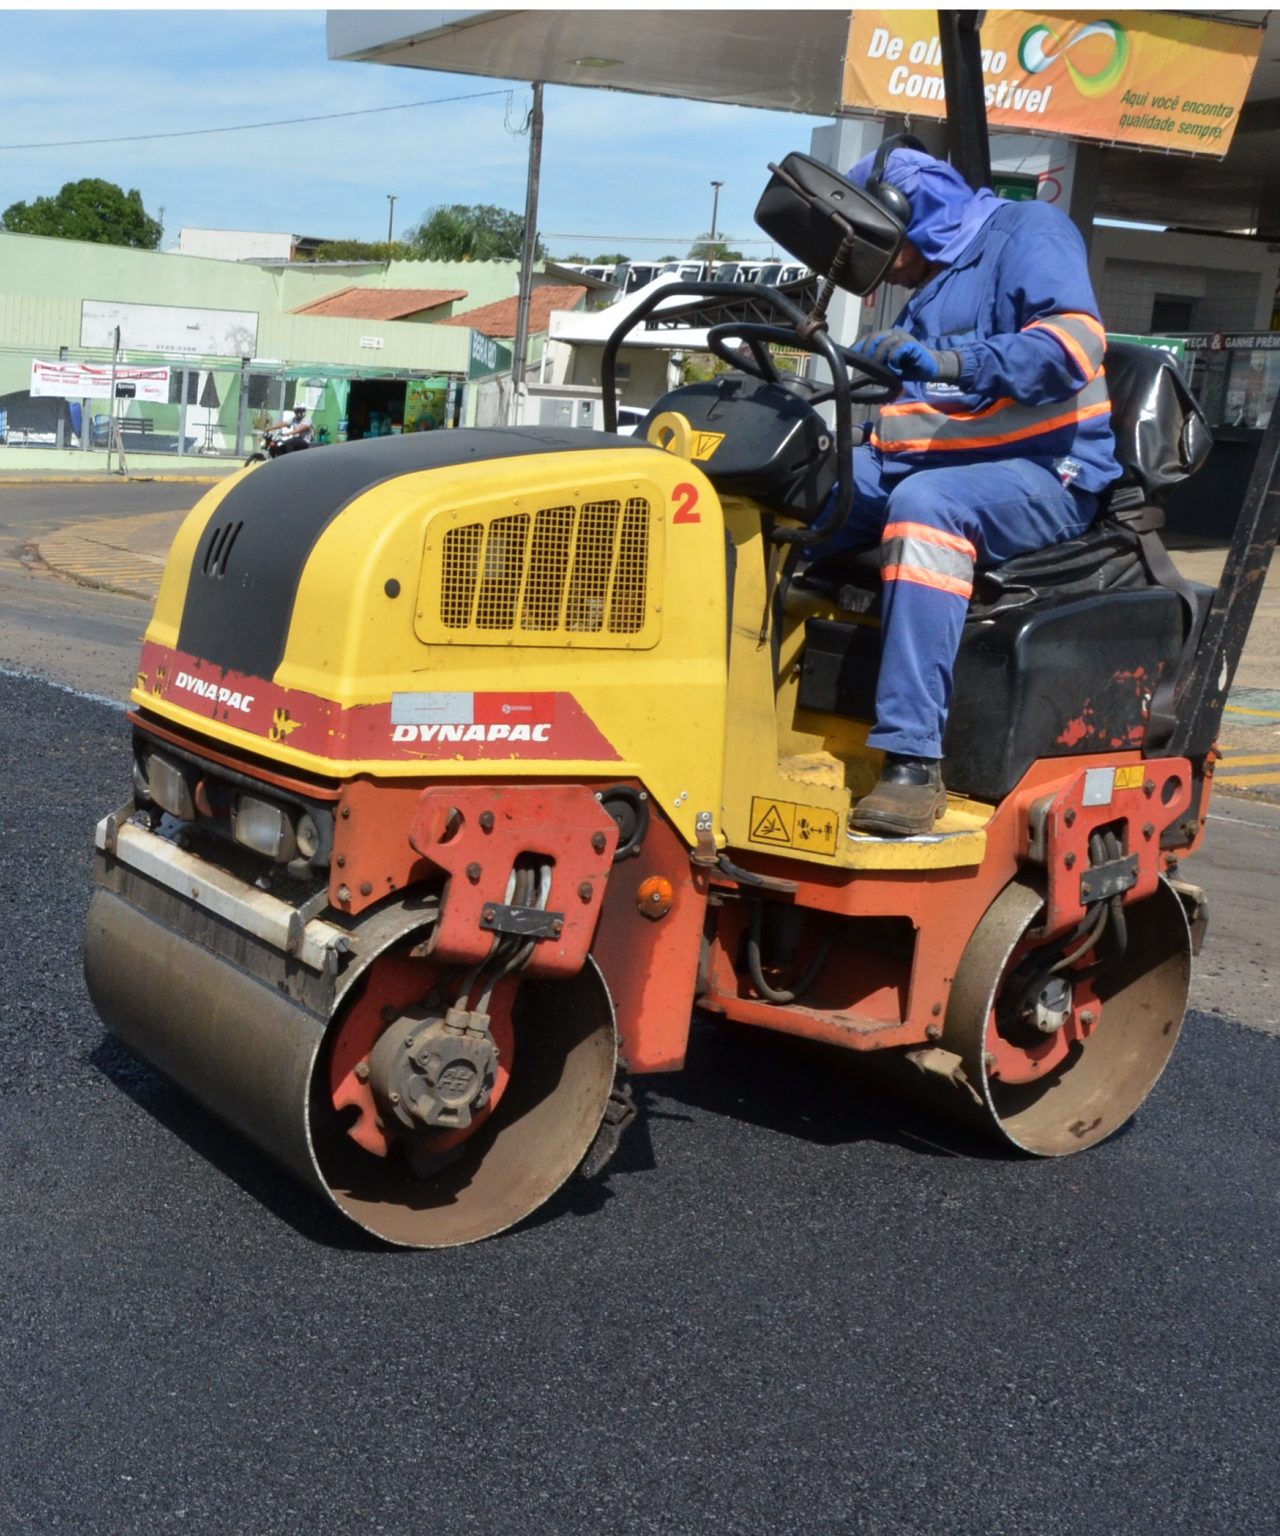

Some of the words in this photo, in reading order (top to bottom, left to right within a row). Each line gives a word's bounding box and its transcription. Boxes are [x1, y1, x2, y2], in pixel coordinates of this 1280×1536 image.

[867, 28, 904, 61] De
[888, 66, 1053, 113] Comstível
[1121, 89, 1150, 108] Aqui
[1151, 95, 1180, 111] você
[1181, 100, 1235, 118] encontra
[1119, 113, 1176, 132] qualidade
[1211, 334, 1222, 350] &
[1224, 337, 1255, 348] GANHE
[671, 483, 701, 524] 2
[175, 671, 255, 713] DYNAPAC
[391, 724, 552, 742] DYNAPAC
